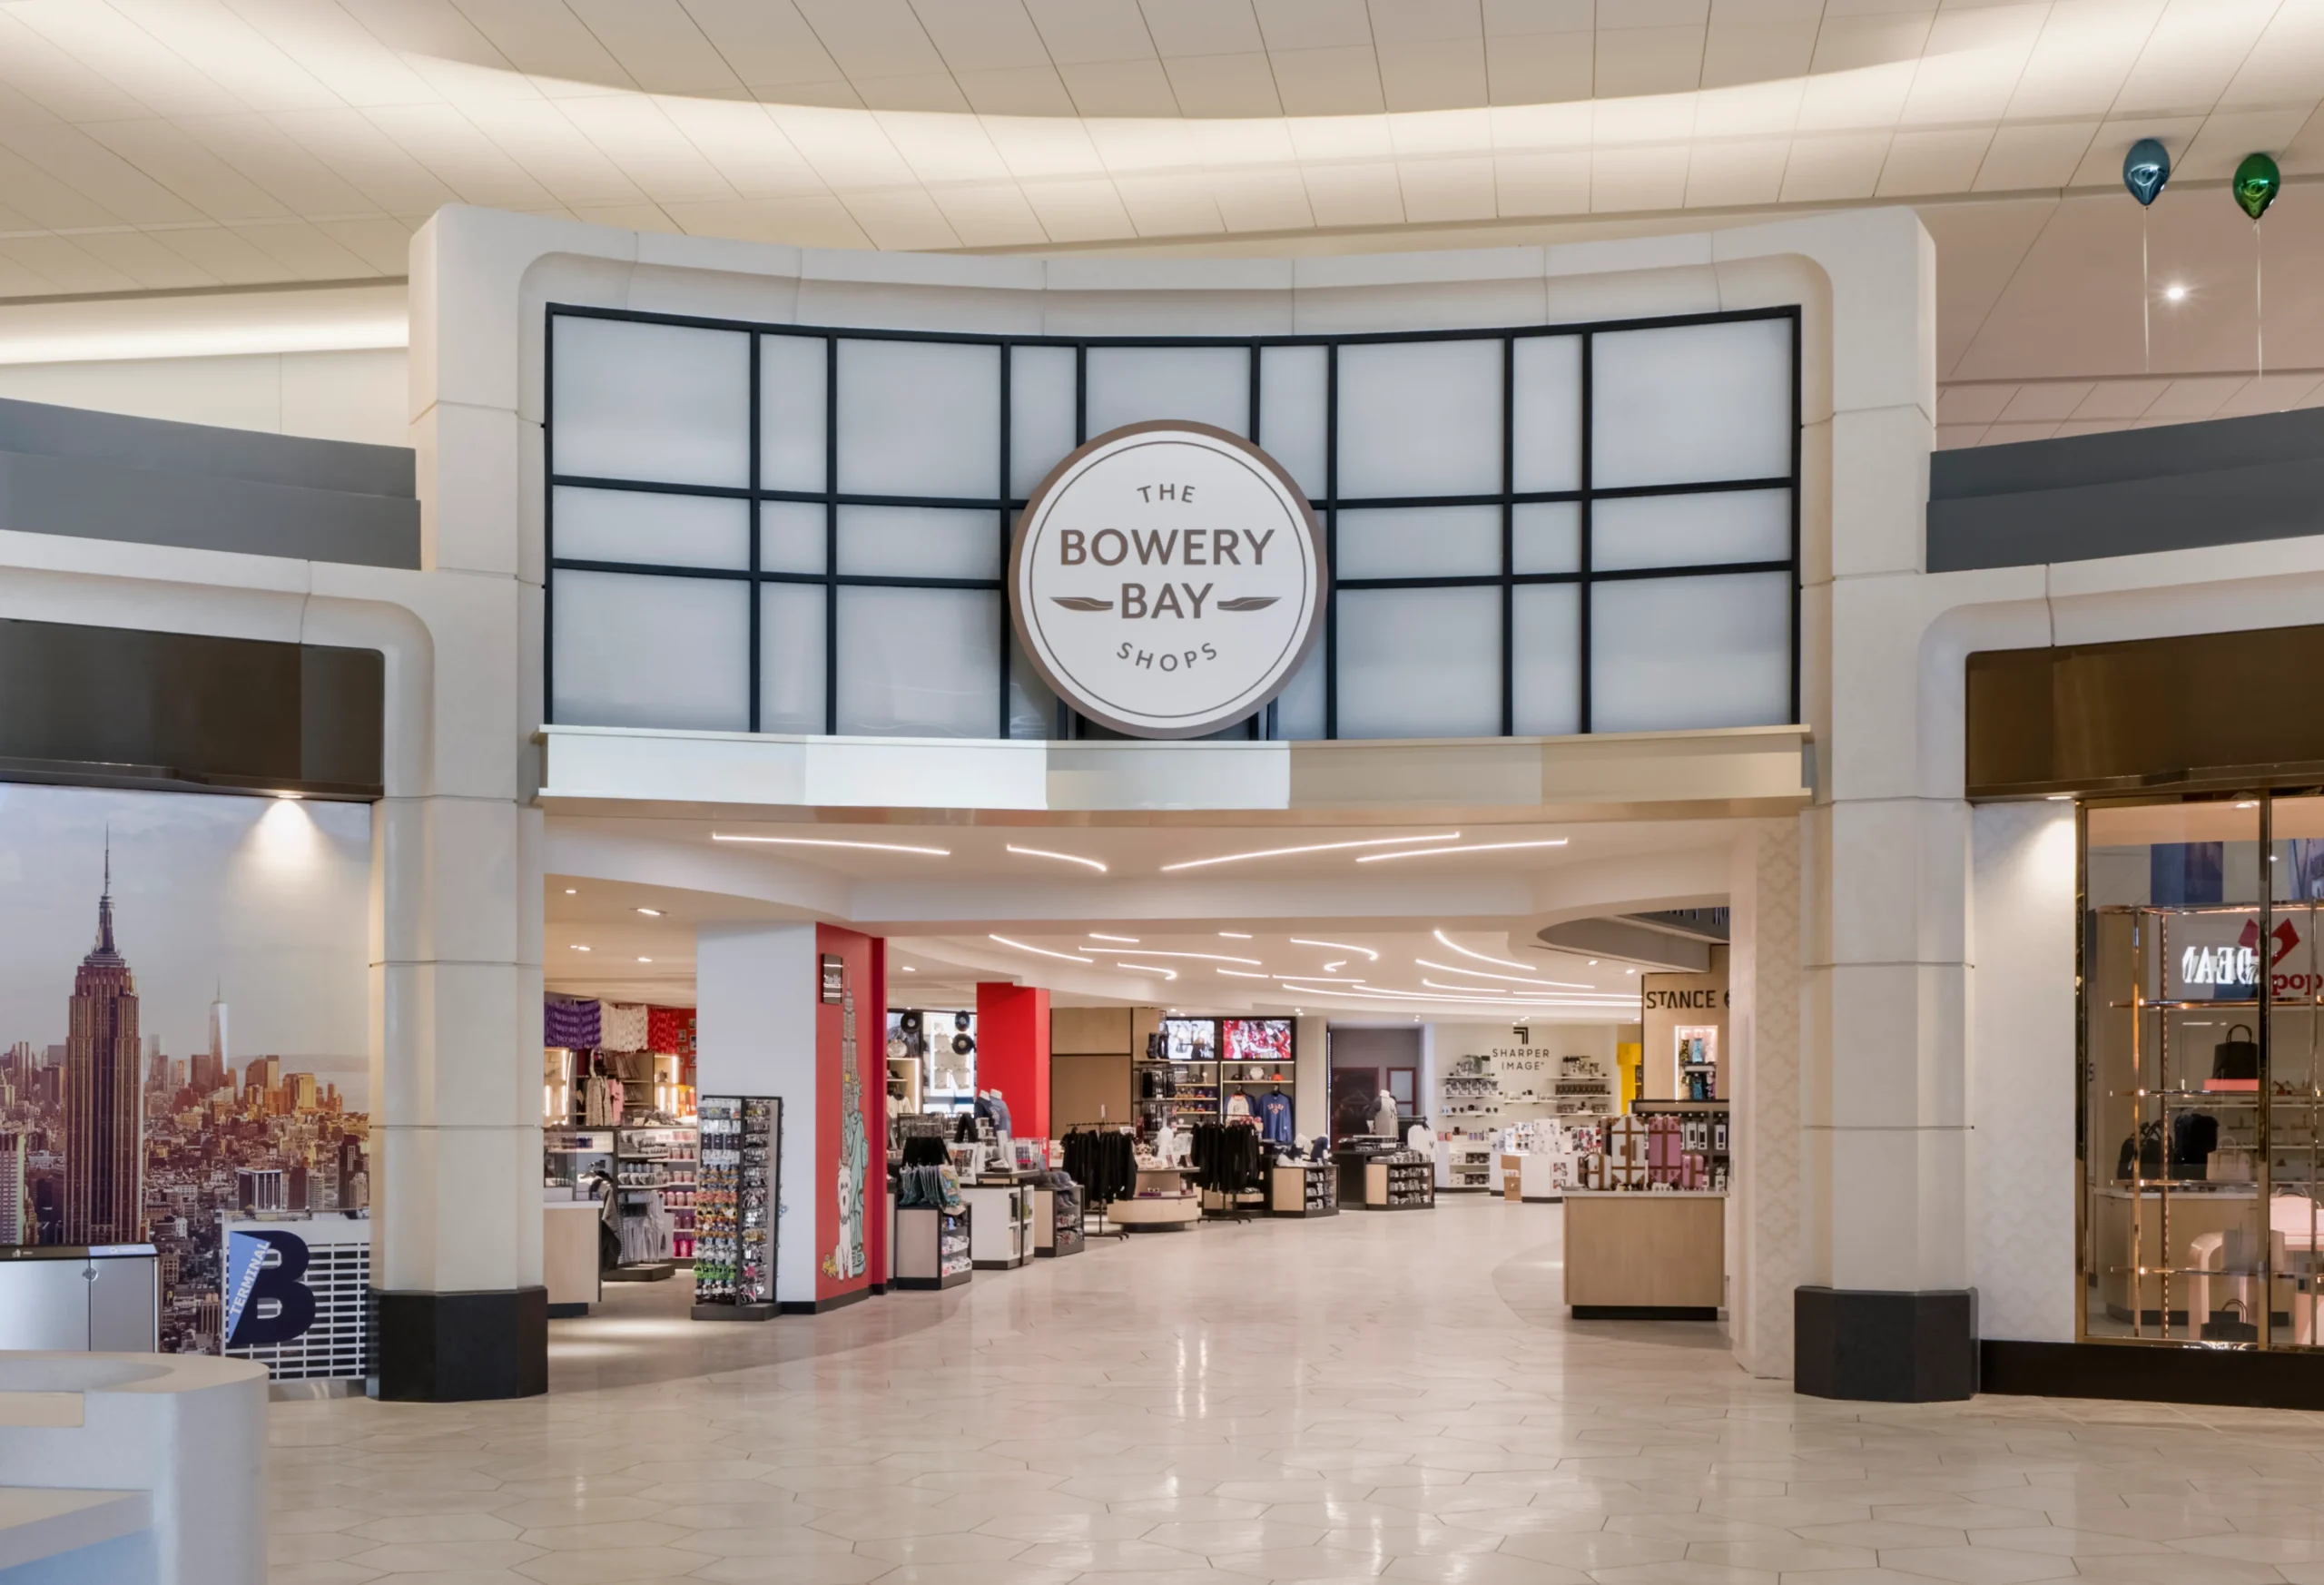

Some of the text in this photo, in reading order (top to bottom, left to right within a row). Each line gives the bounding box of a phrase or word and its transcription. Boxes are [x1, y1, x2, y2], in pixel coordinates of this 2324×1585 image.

[1137, 483, 1196, 504] THE
[1060, 528, 1275, 566] BOWERY
[1121, 583, 1214, 619] BAY
[1117, 642, 1217, 672] SHOPS
[1646, 990, 1716, 1009] STANCE
[1492, 1048, 1550, 1058] SHARPER
[228, 1230, 316, 1345] TERMINAL B
